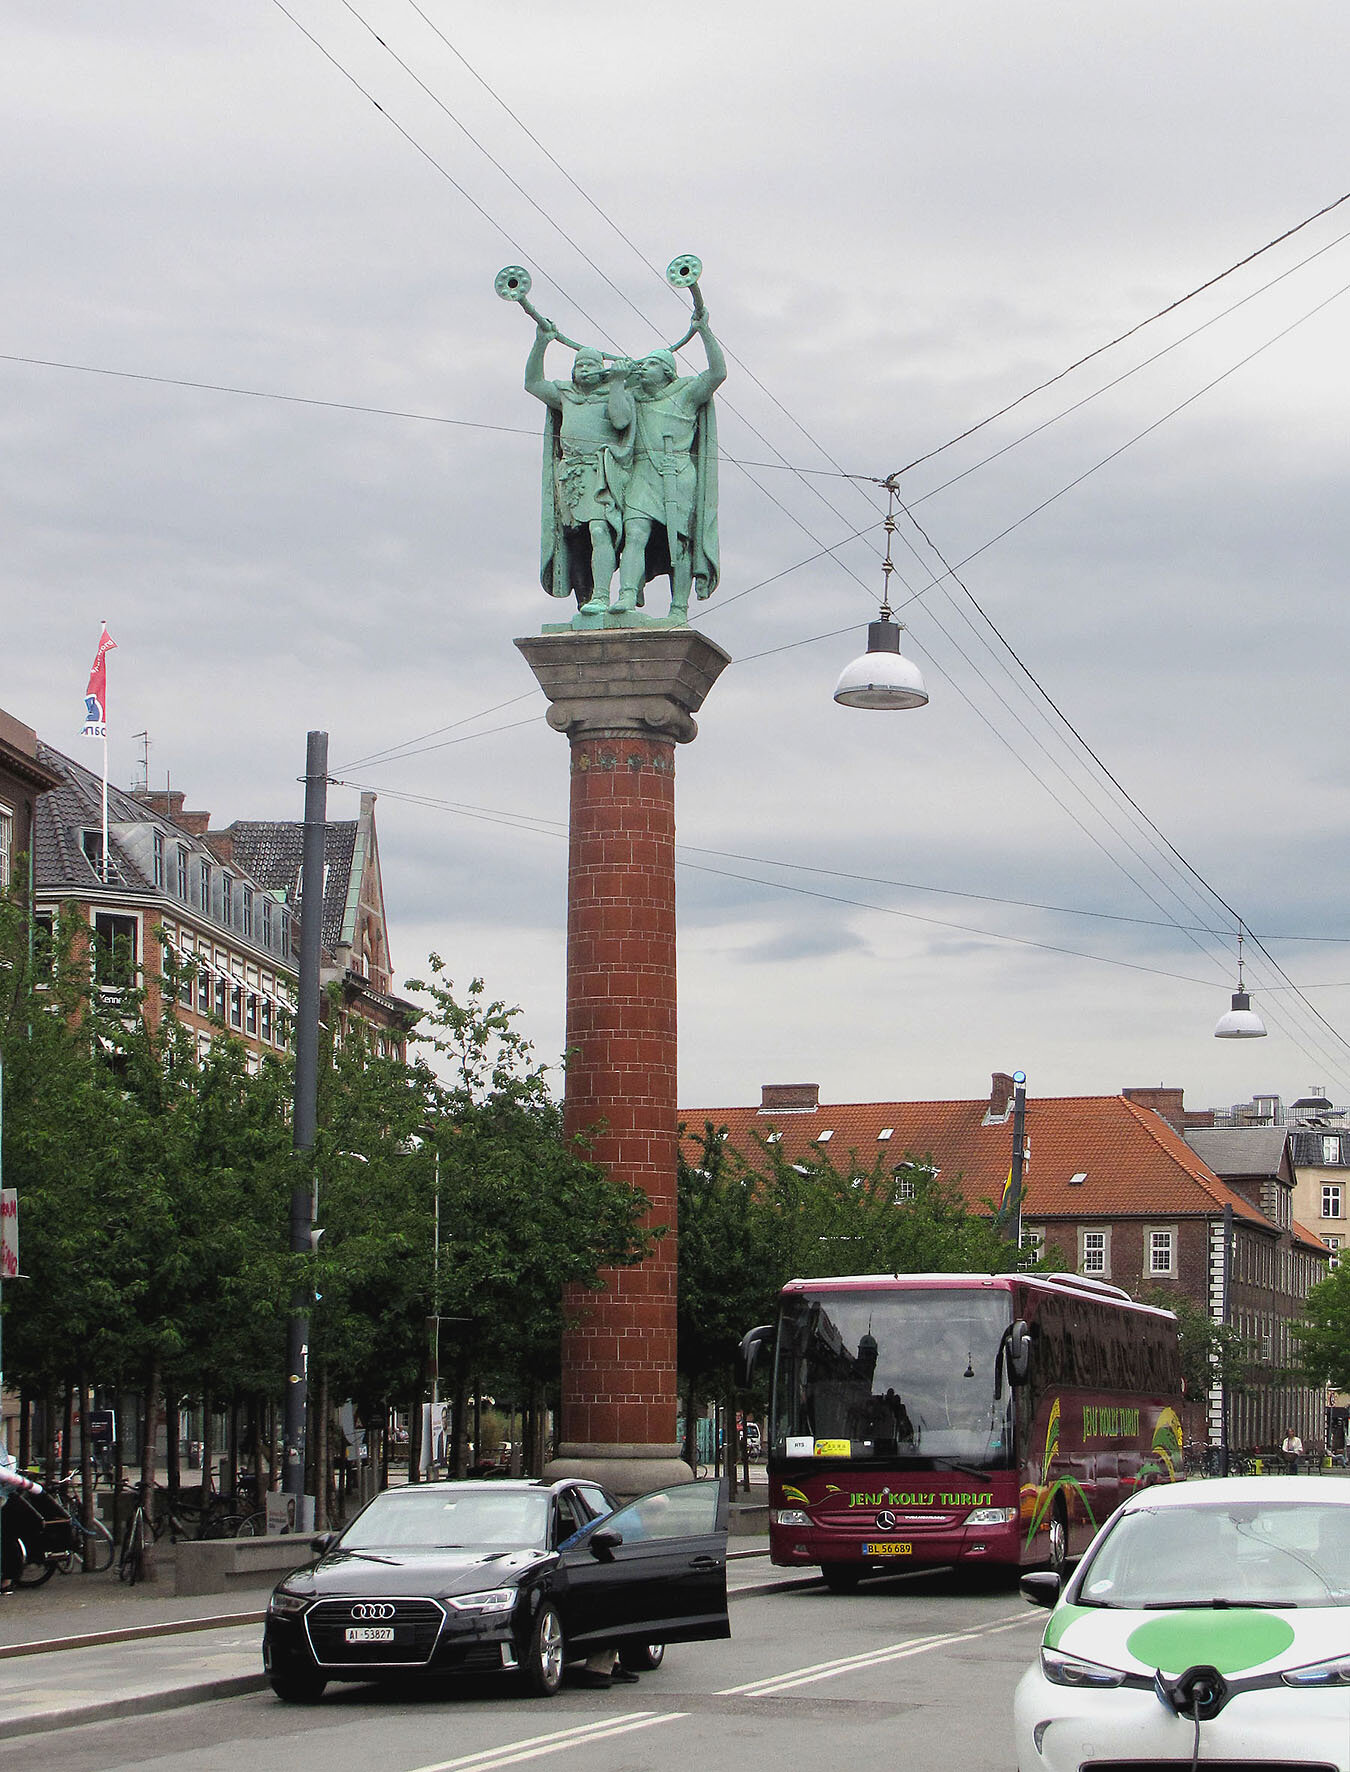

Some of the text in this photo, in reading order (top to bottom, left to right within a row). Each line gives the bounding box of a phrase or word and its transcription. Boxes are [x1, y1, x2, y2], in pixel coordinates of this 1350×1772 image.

[848, 1492, 994, 1507] JENS KOLL'S TURIST
[868, 1544, 880, 1553] BL
